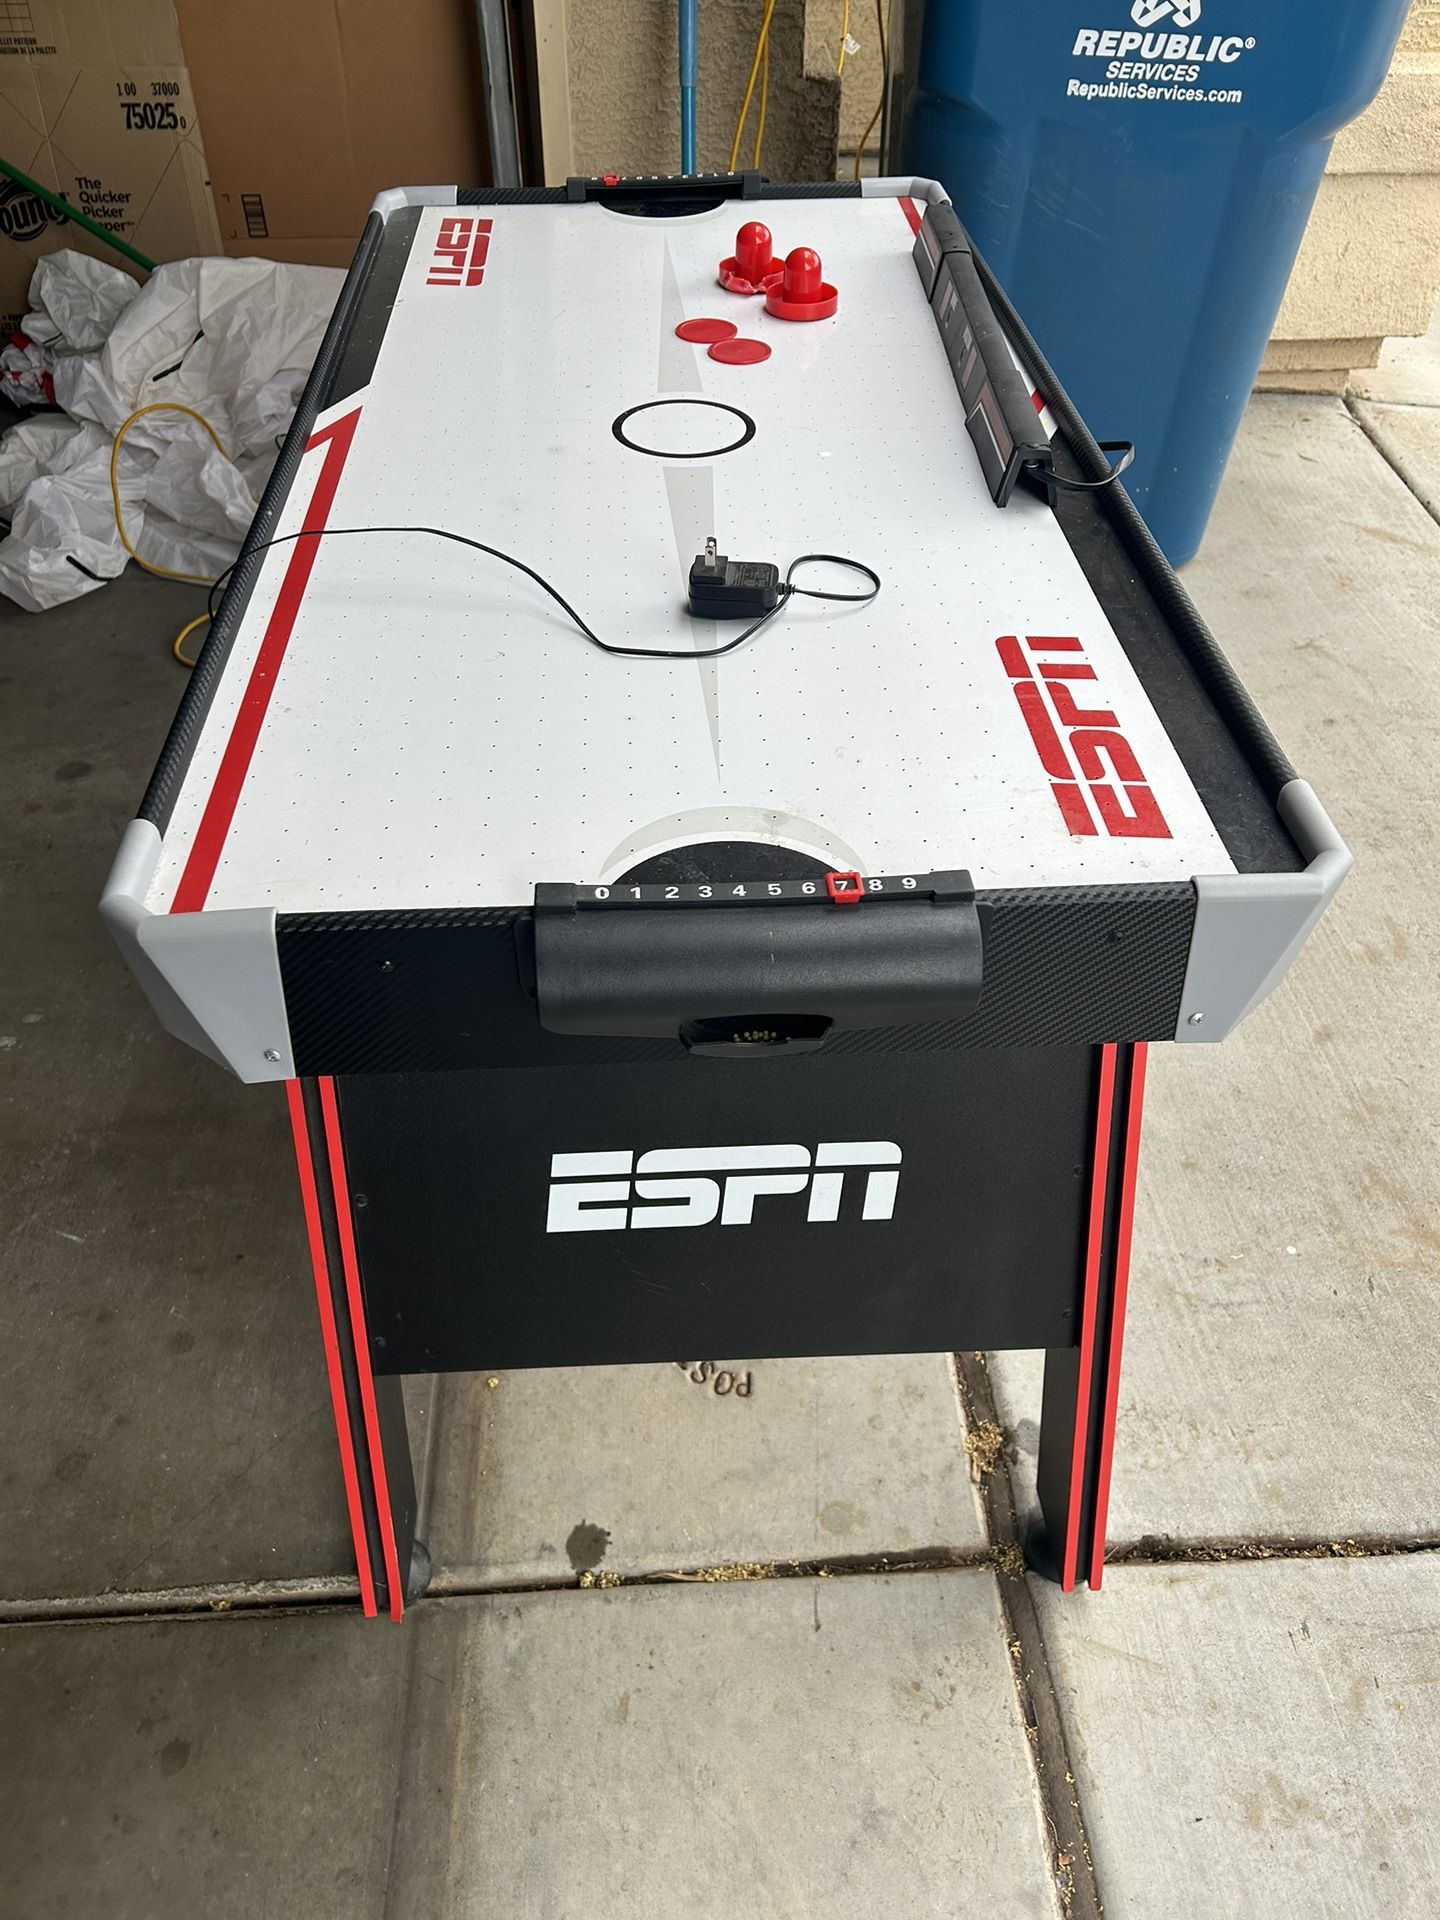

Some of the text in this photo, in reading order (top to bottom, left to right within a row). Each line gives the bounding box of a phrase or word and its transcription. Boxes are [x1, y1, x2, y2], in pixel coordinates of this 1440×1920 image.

[1105, 61, 1200, 82] SERVICES
[150, 82, 180, 96] 37000
[1066, 79, 1242, 103] RepublicServices.com
[120, 102, 179, 130] 75025
[75, 177, 102, 190] The
[79, 190, 131, 205] Quicker
[82, 205, 125, 219] Picker
[425, 217, 494, 287] ESPN
[995, 635, 1174, 839] ESPN
[594, 877, 917, 899] 0 1 2 3 4 5 6 7 8 9
[546, 1141, 903, 1233] ESPN
[678, 1361, 752, 1397] POS
